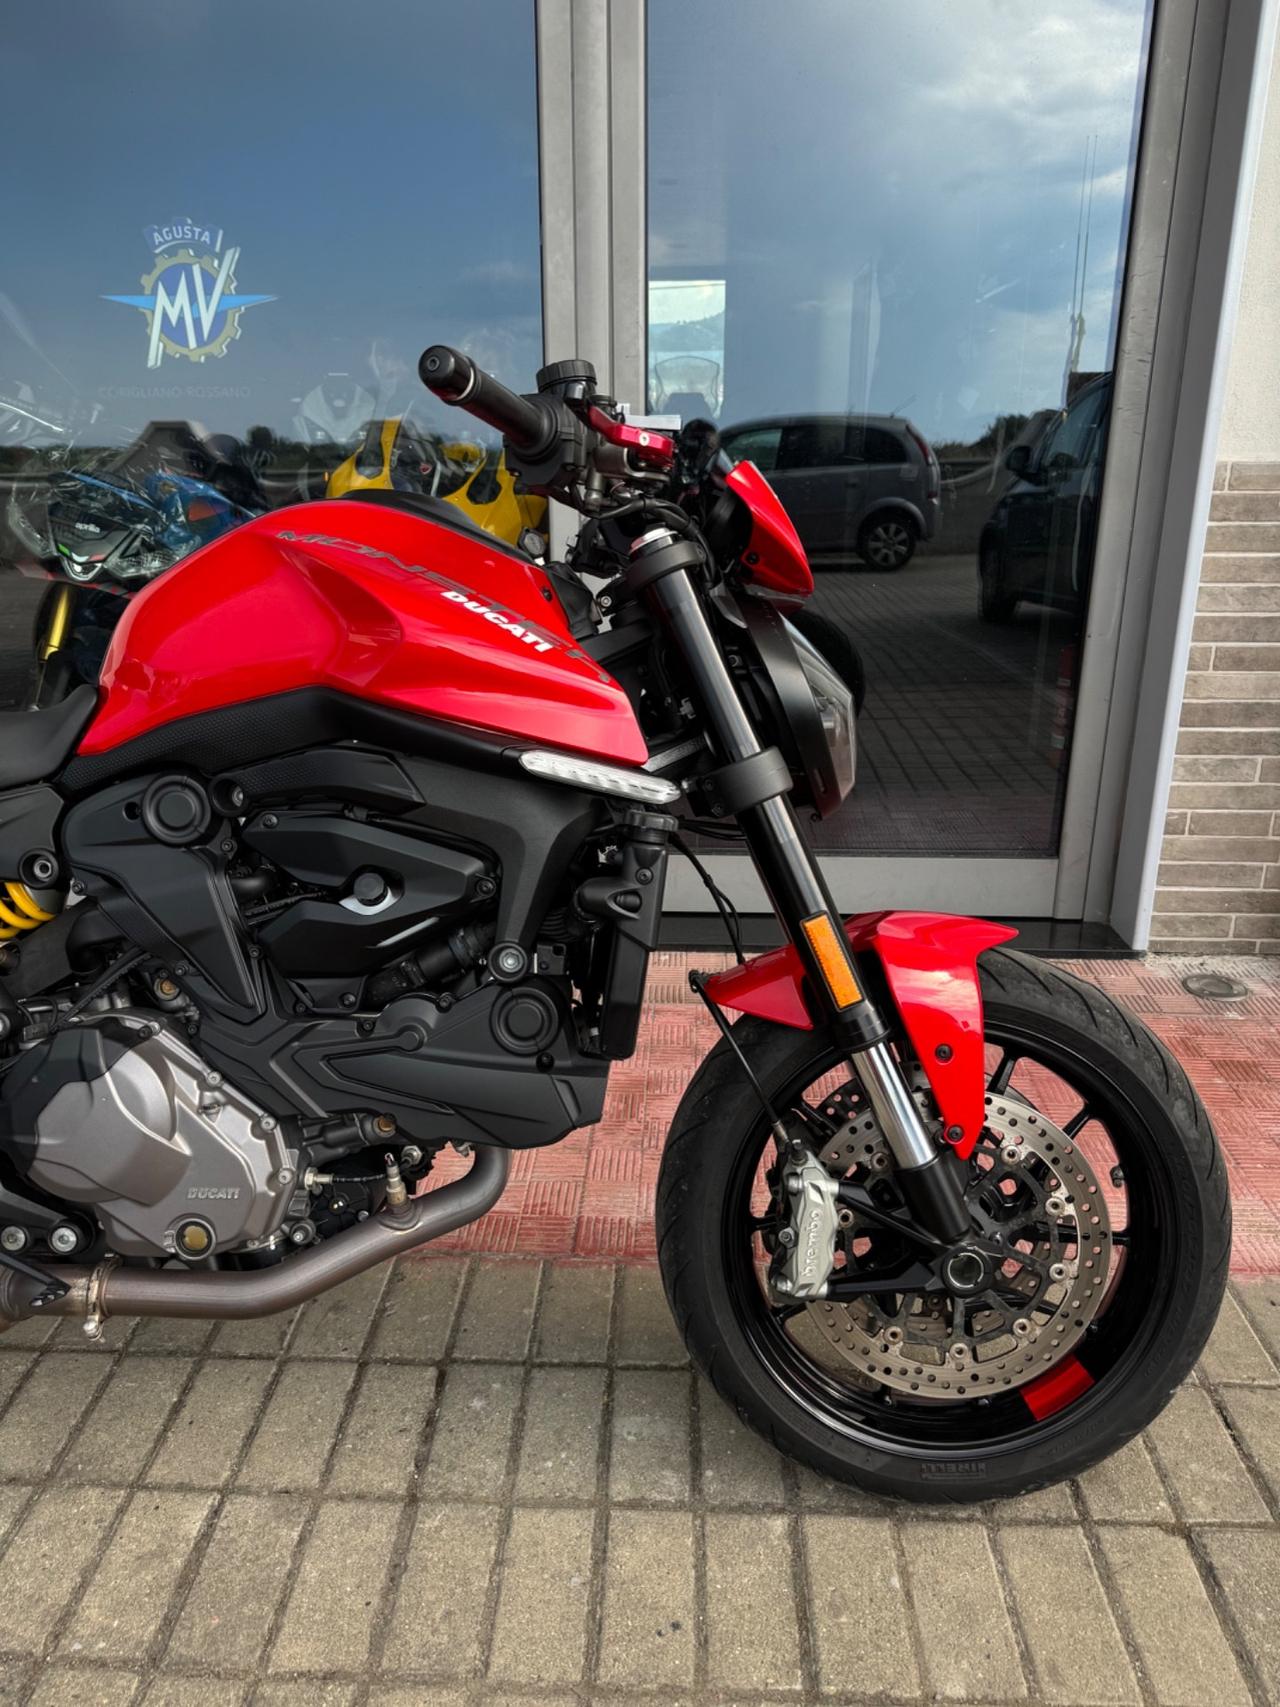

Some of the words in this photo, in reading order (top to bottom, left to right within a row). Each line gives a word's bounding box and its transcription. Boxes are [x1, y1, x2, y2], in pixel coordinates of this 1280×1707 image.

[152, 225, 211, 245] AGUSTA
[147, 247, 239, 368] MV
[441, 591, 553, 653] DUCATI
[187, 1187, 241, 1199] DUCATI
[801, 1209, 821, 1277] brembo
